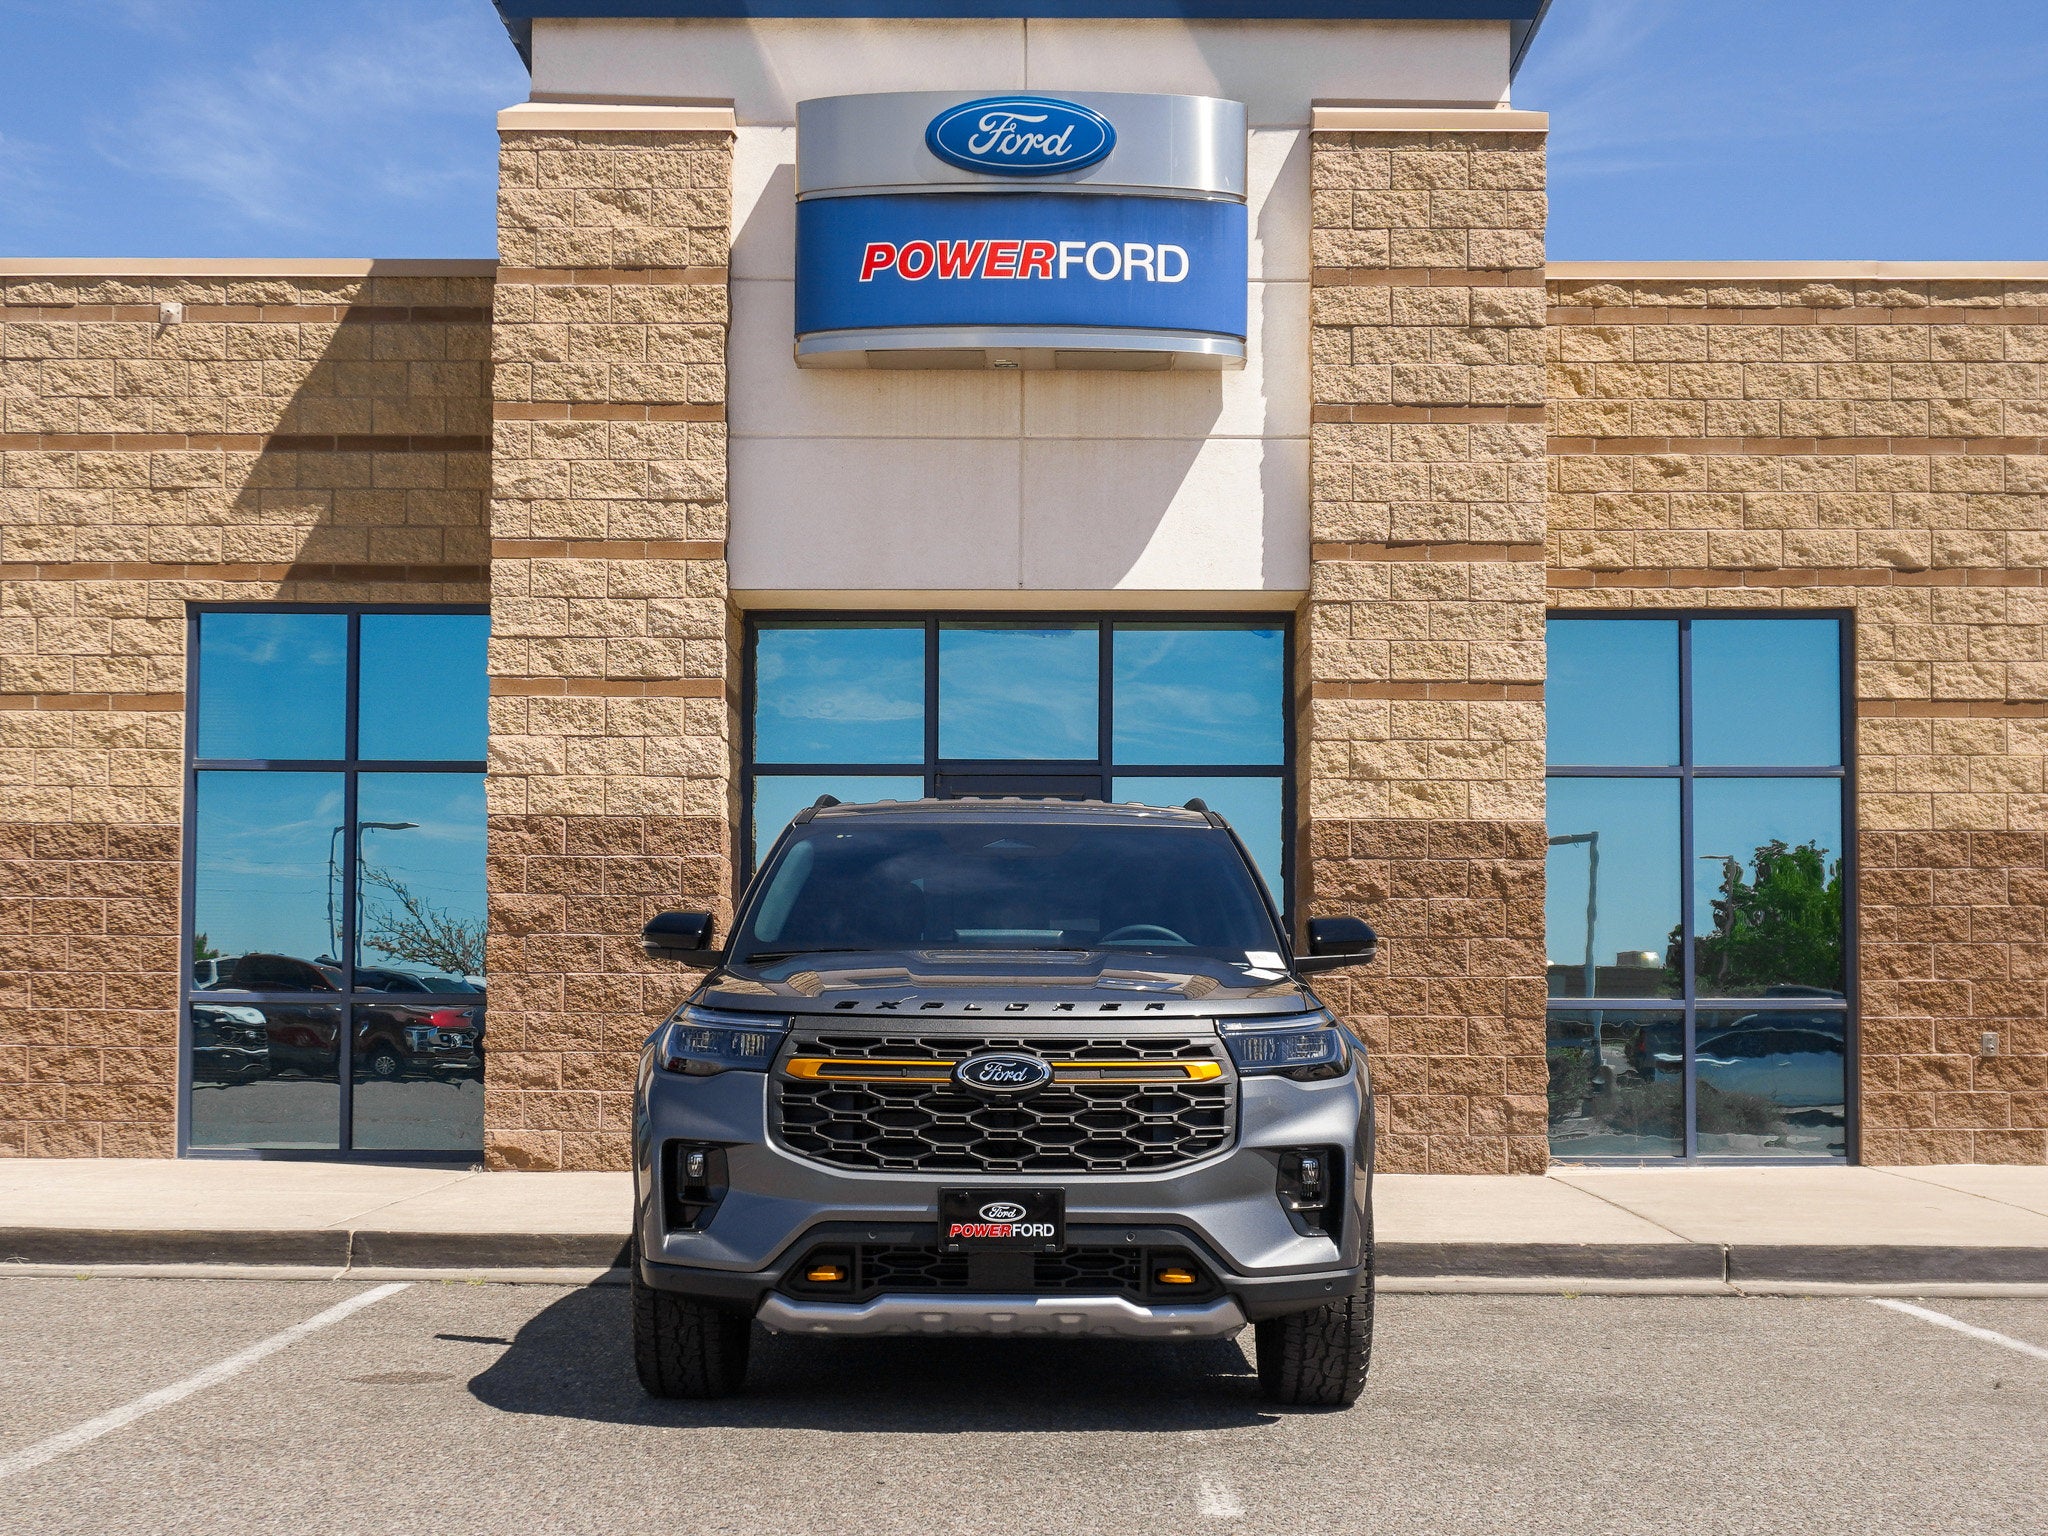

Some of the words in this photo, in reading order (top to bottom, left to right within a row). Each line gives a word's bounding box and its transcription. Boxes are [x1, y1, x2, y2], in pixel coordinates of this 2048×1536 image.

[968, 112, 1075, 156] Ford
[859, 239, 1190, 283] POWERFORD
[833, 1000, 1166, 1012] EXPLORER
[980, 1061, 1028, 1082] Ford
[988, 1206, 1017, 1218] Ford
[949, 1223, 1055, 1238] POWERFORD
